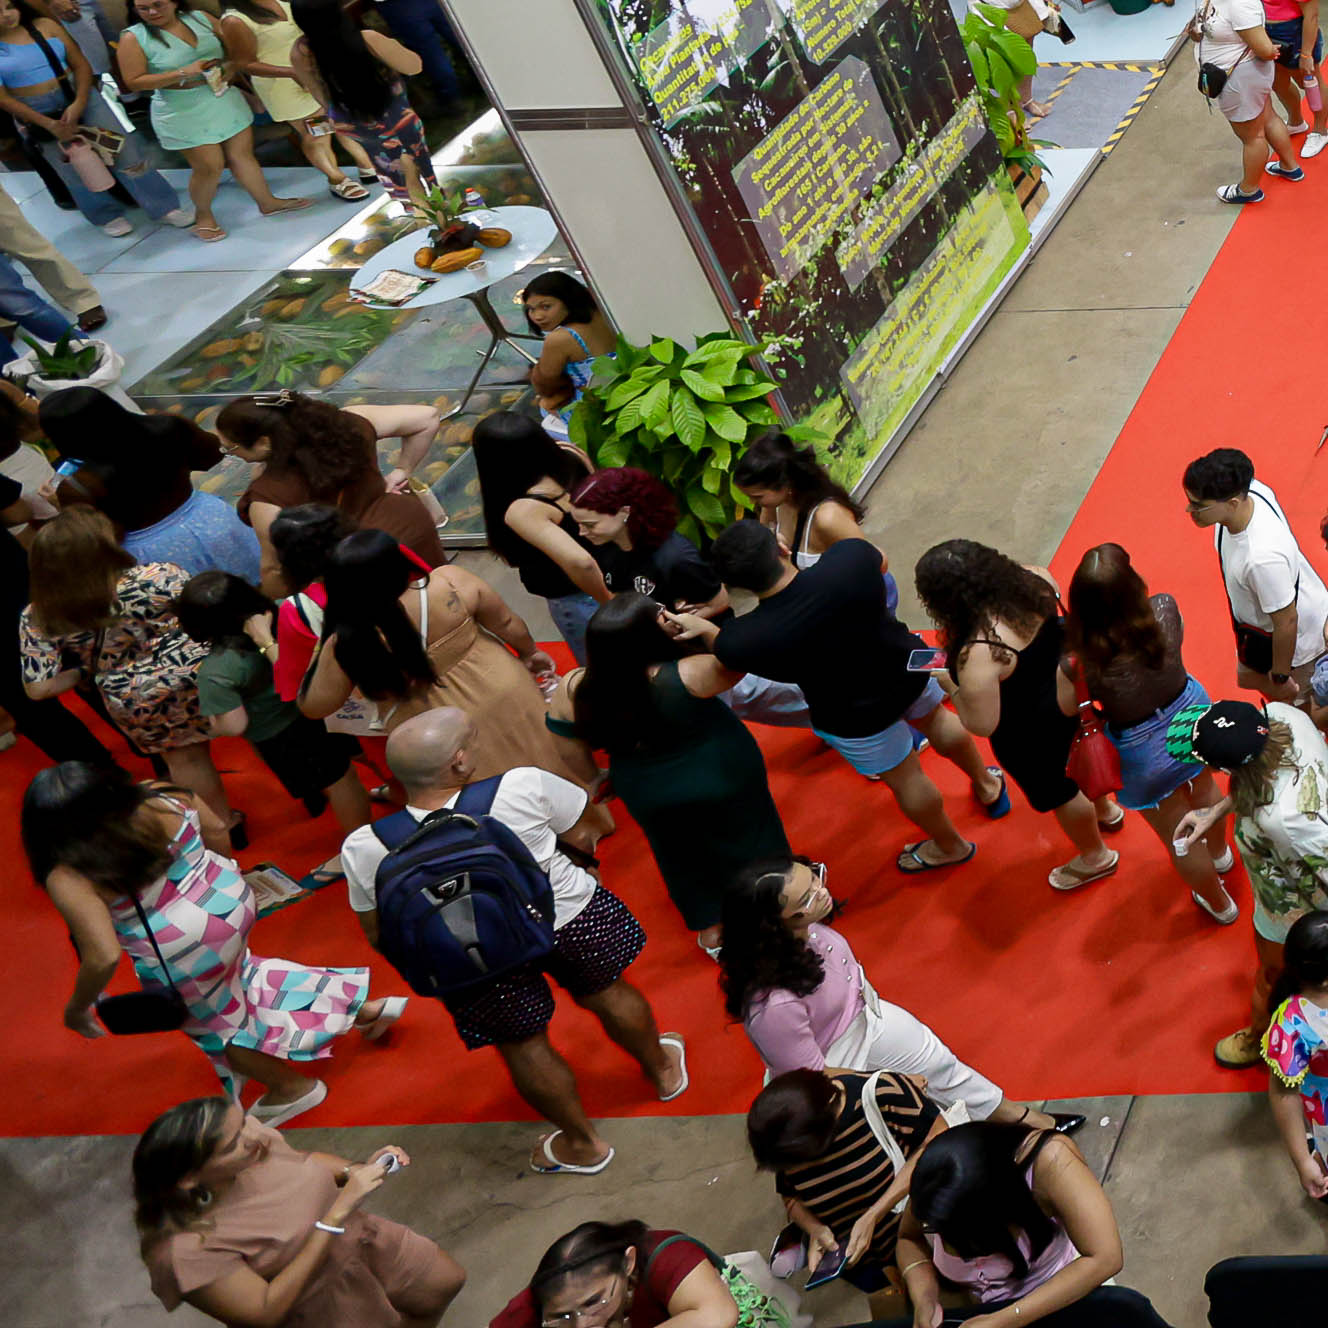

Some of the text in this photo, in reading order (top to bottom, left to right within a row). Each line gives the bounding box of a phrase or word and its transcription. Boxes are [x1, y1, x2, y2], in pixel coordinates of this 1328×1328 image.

[752, 109, 800, 162] Quantidade
[808, 68, 841, 107] Carbono
[749, 126, 802, 187] Sequestrada
[762, 140, 809, 193] Cacaueiros
[756, 155, 814, 223] Agroflorestais
